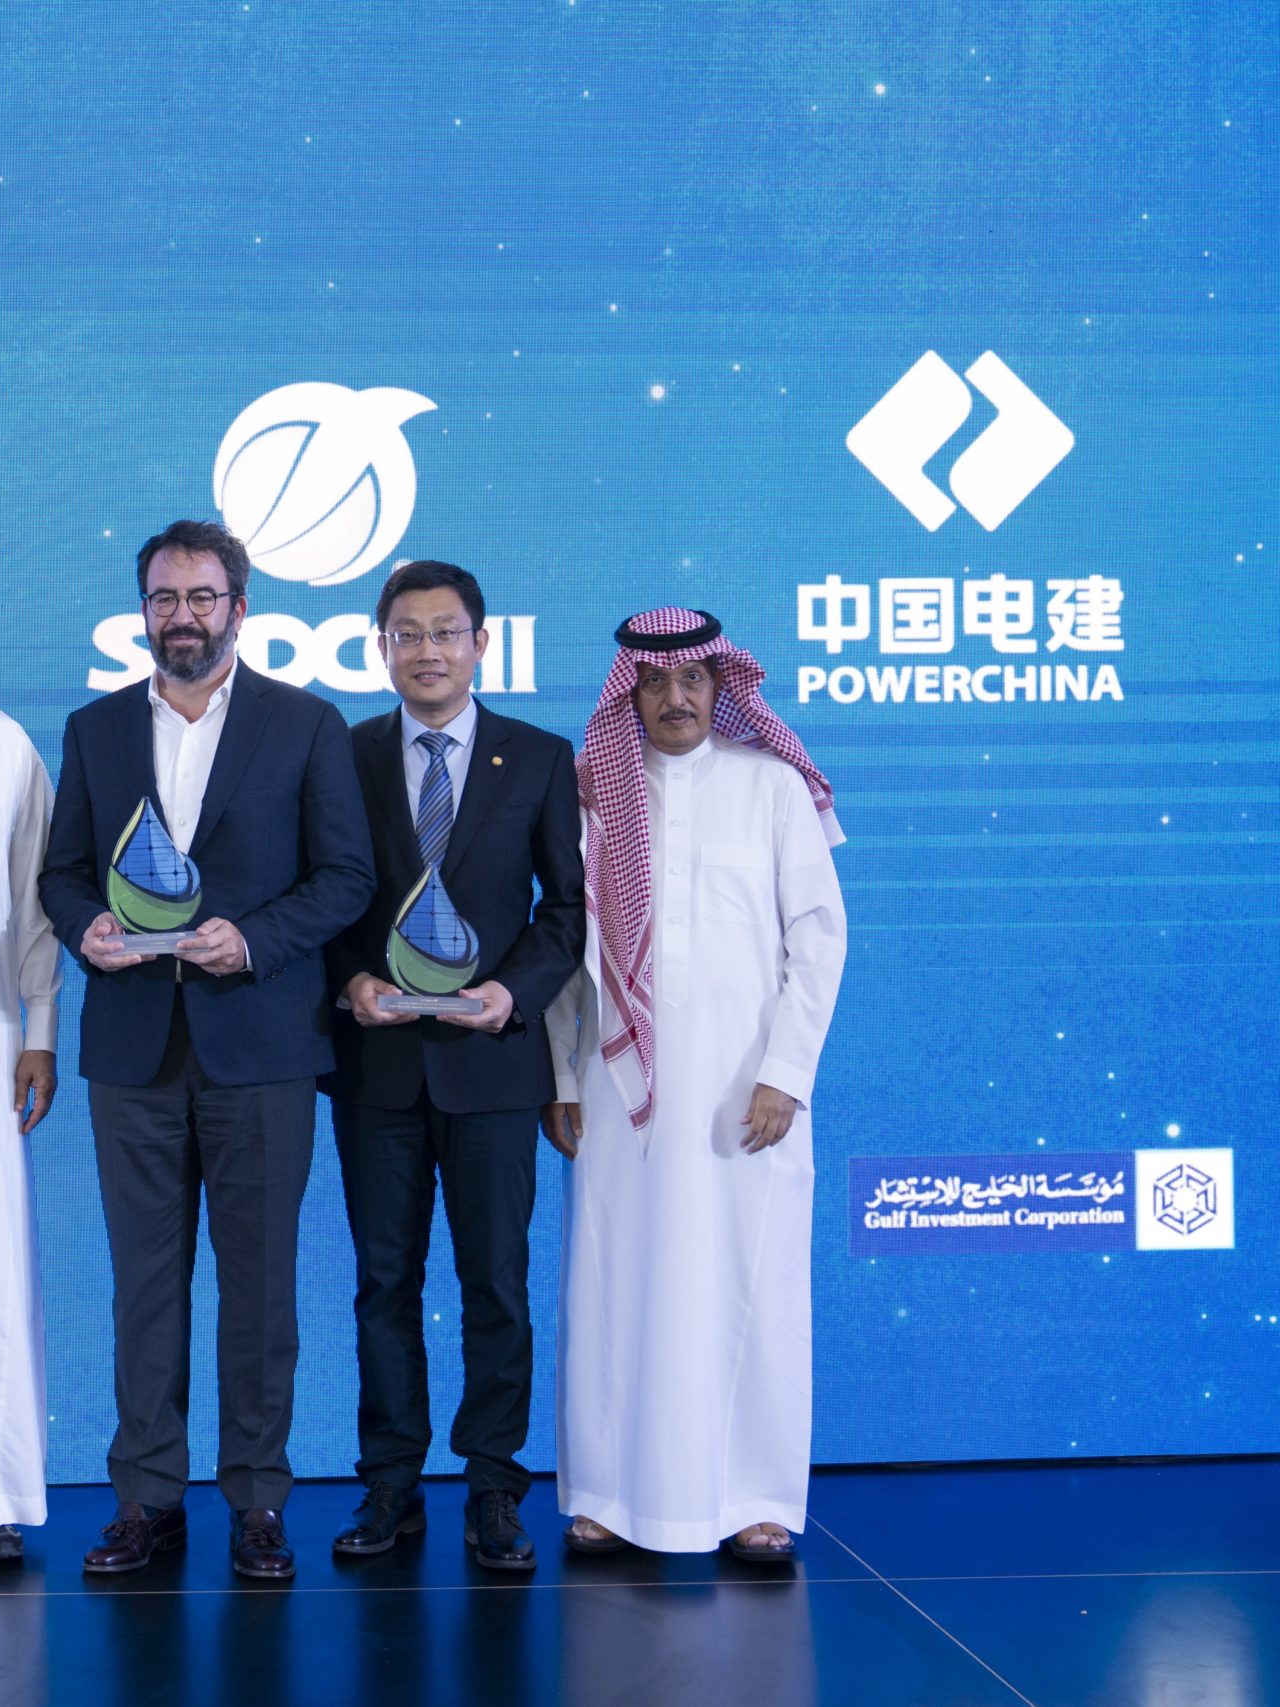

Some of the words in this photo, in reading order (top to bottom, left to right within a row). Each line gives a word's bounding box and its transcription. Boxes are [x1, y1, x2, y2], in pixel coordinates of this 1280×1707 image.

[797, 573, 1125, 654] 中国电建
[797, 665, 1125, 703] POWERCHINA
[864, 1210, 908, 1229] Gulf
[910, 1209, 1011, 1228] Investment
[1014, 1207, 1125, 1230] Corporation
